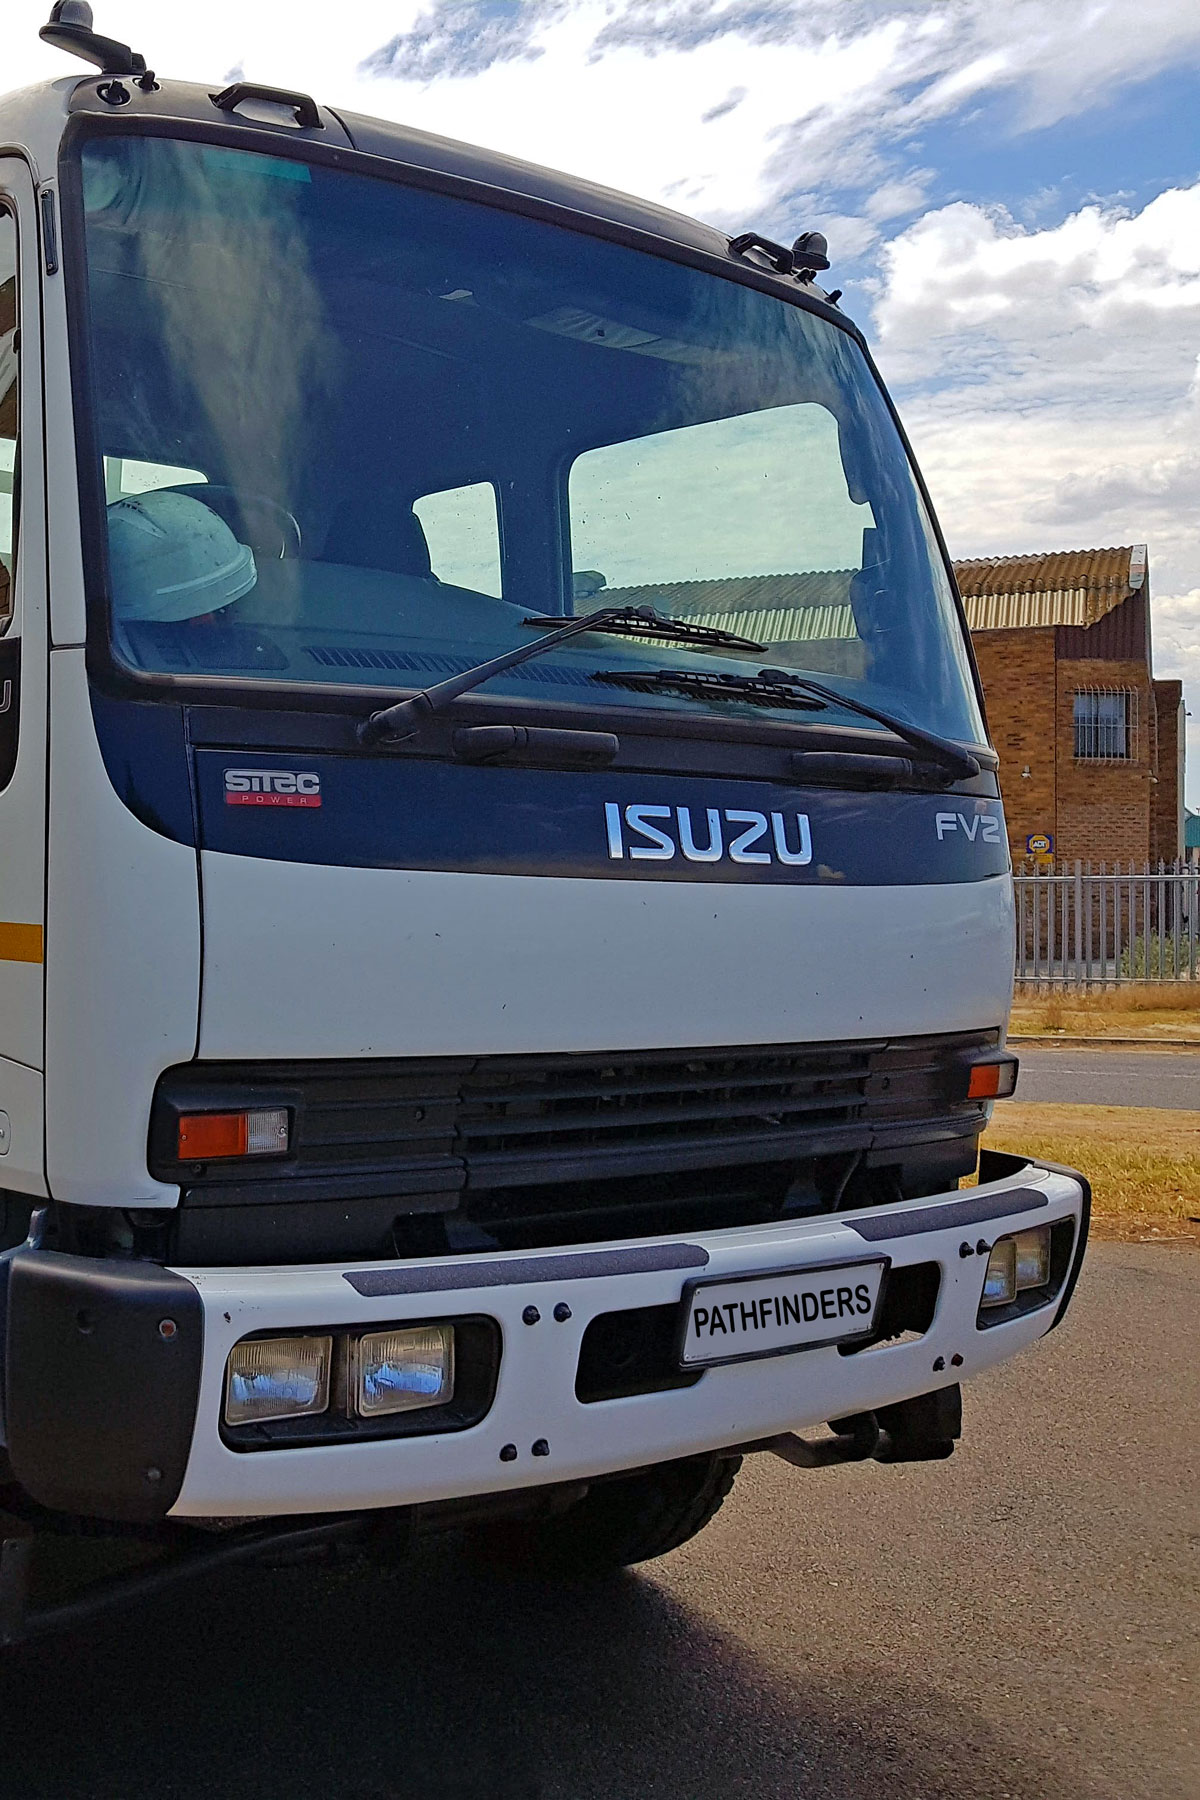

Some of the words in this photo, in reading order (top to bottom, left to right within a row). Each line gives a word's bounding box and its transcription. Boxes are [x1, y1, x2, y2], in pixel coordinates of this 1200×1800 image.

[241, 795, 307, 804] POWER
[604, 802, 814, 866] ISUZU
[1033, 840, 1046, 848] ADT
[693, 1284, 872, 1338] PATHFINDERS
